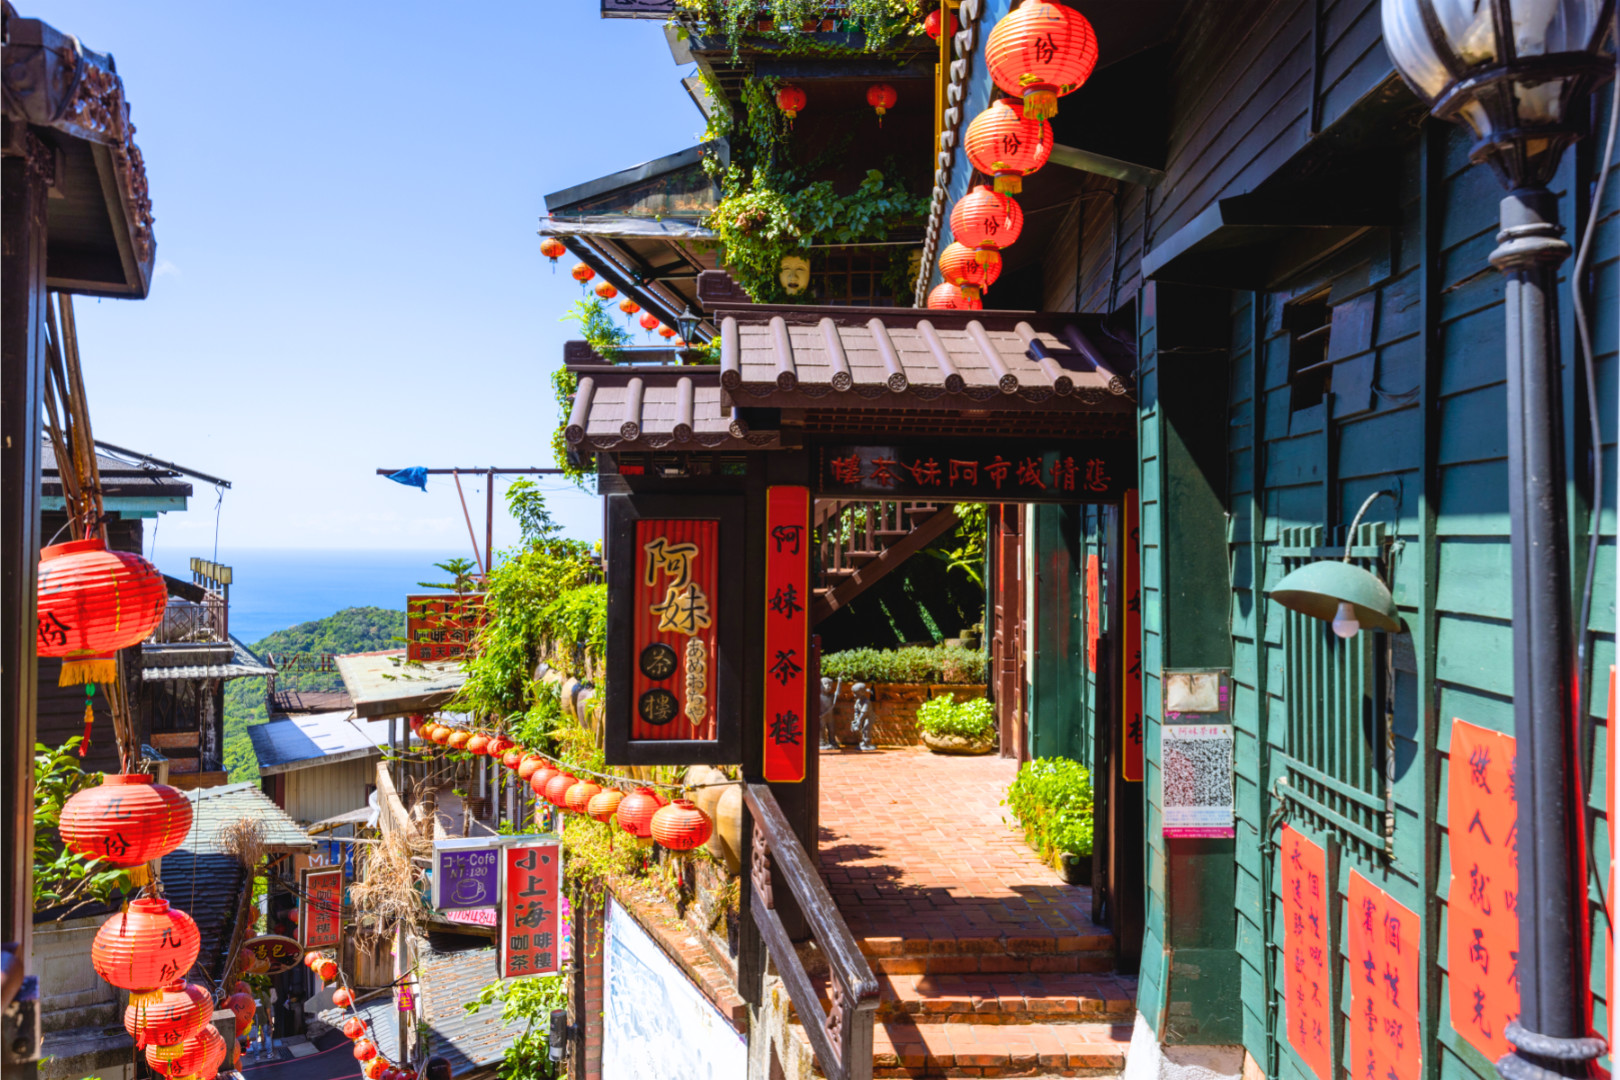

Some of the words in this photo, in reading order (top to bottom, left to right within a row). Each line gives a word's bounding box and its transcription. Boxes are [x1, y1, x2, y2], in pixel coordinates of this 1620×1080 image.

[644, 538, 711, 634] 阿妹
[767, 524, 804, 746] 阿妹茶樓
[103, 797, 131, 857] 九份
[514, 849, 552, 929] 小上海
[160, 927, 182, 982] 九份
[509, 952, 553, 971] 茶樓
[510, 932, 553, 951] 咖啡
